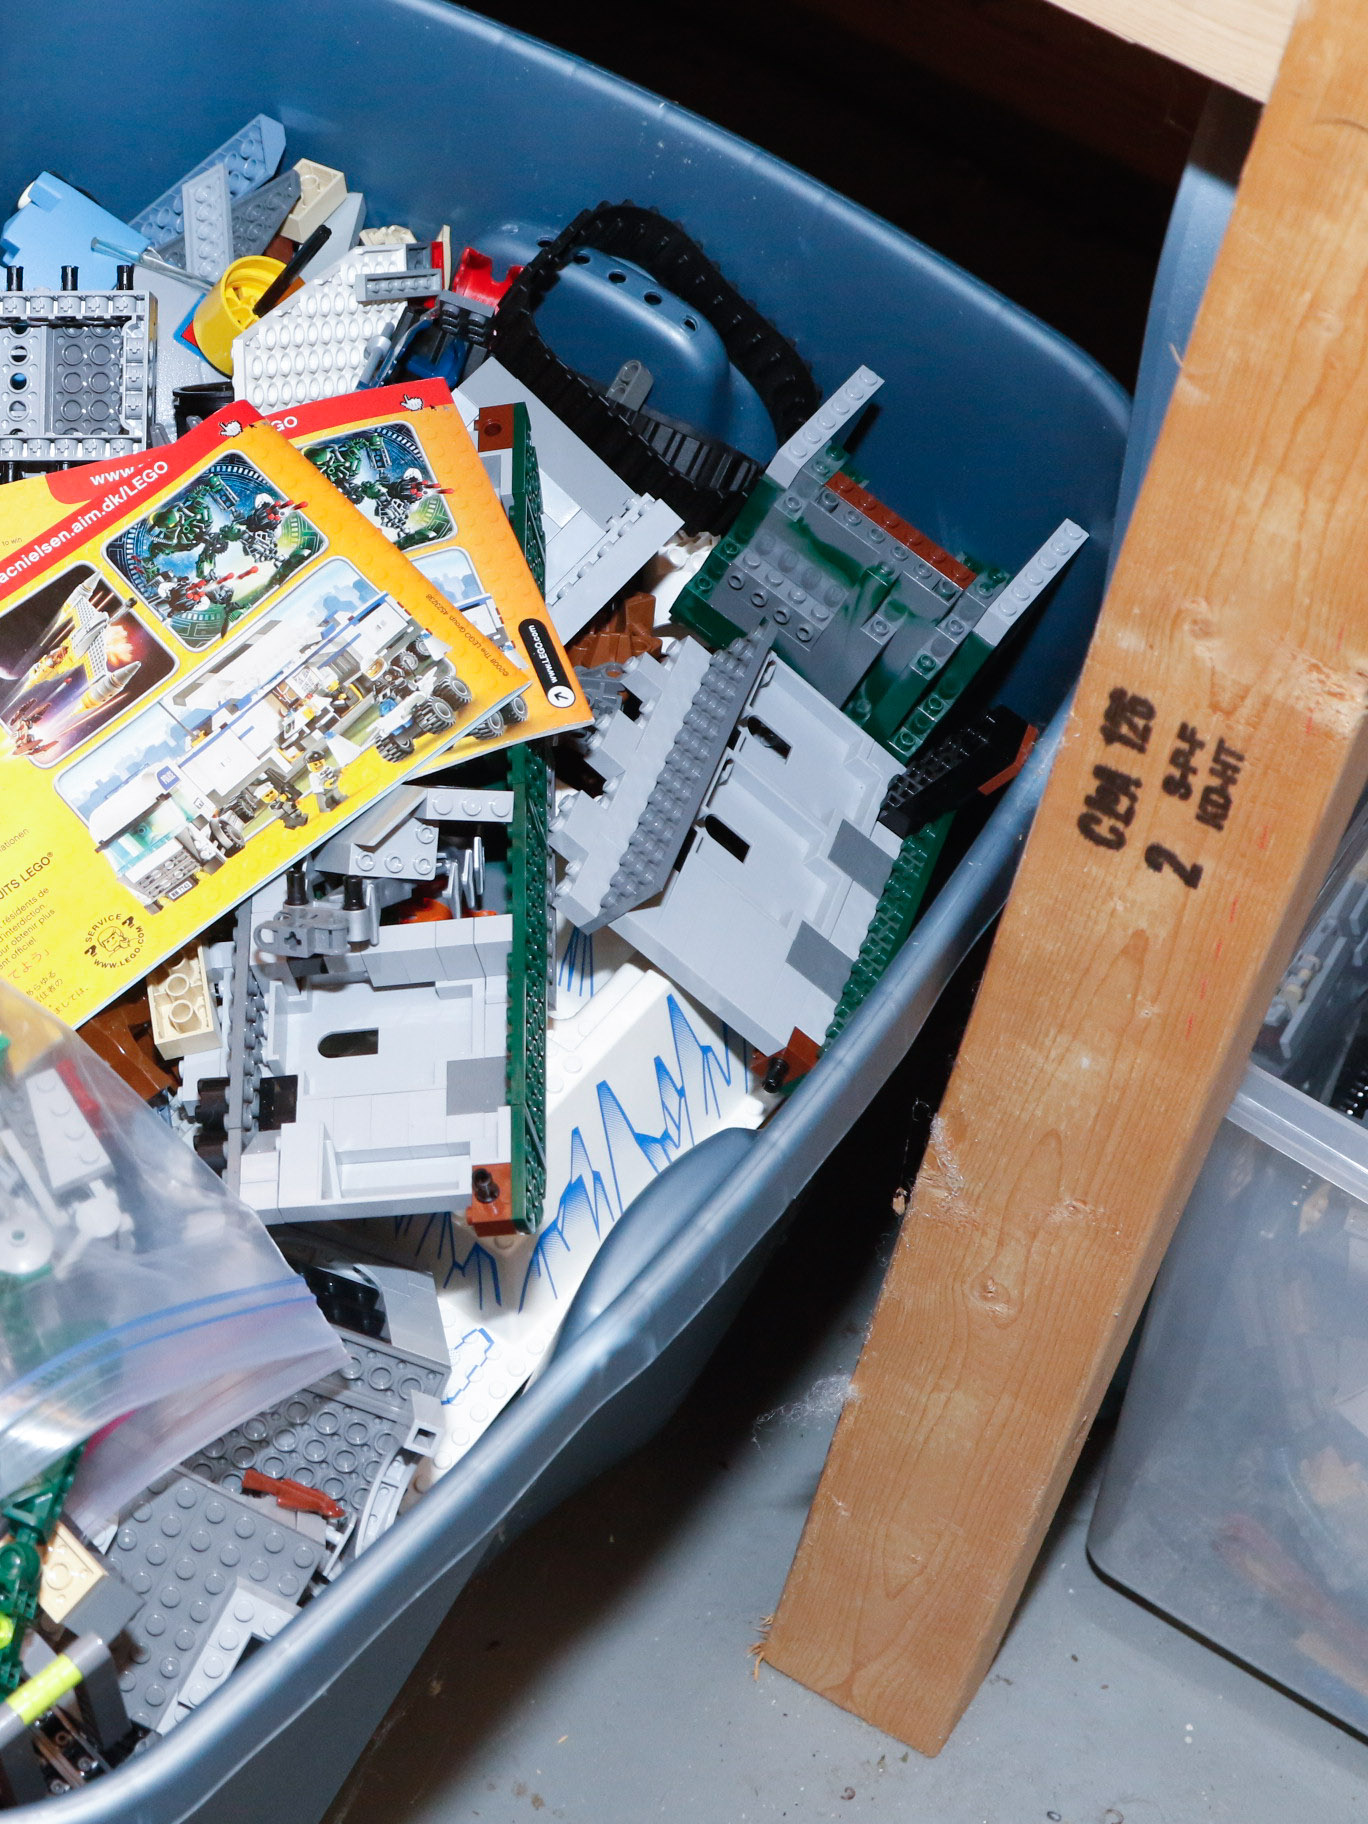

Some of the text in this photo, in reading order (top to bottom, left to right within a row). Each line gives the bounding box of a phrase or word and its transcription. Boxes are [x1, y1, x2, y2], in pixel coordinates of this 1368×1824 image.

[465, 632, 482, 648] LEGO
[481, 648, 491, 659] The
[528, 625, 559, 684] www.LEGO.com
[1144, 842, 1203, 889] 2
[2, 897, 37, 924] résidents
[38, 888, 49, 898] de
[11, 923, 37, 946] obtenir
[38, 909, 55, 925] plus
[85, 914, 122, 943] SERVICE
[11, 936, 36, 959] officiel
[94, 926, 144, 969] WWW.LEGO.COM
